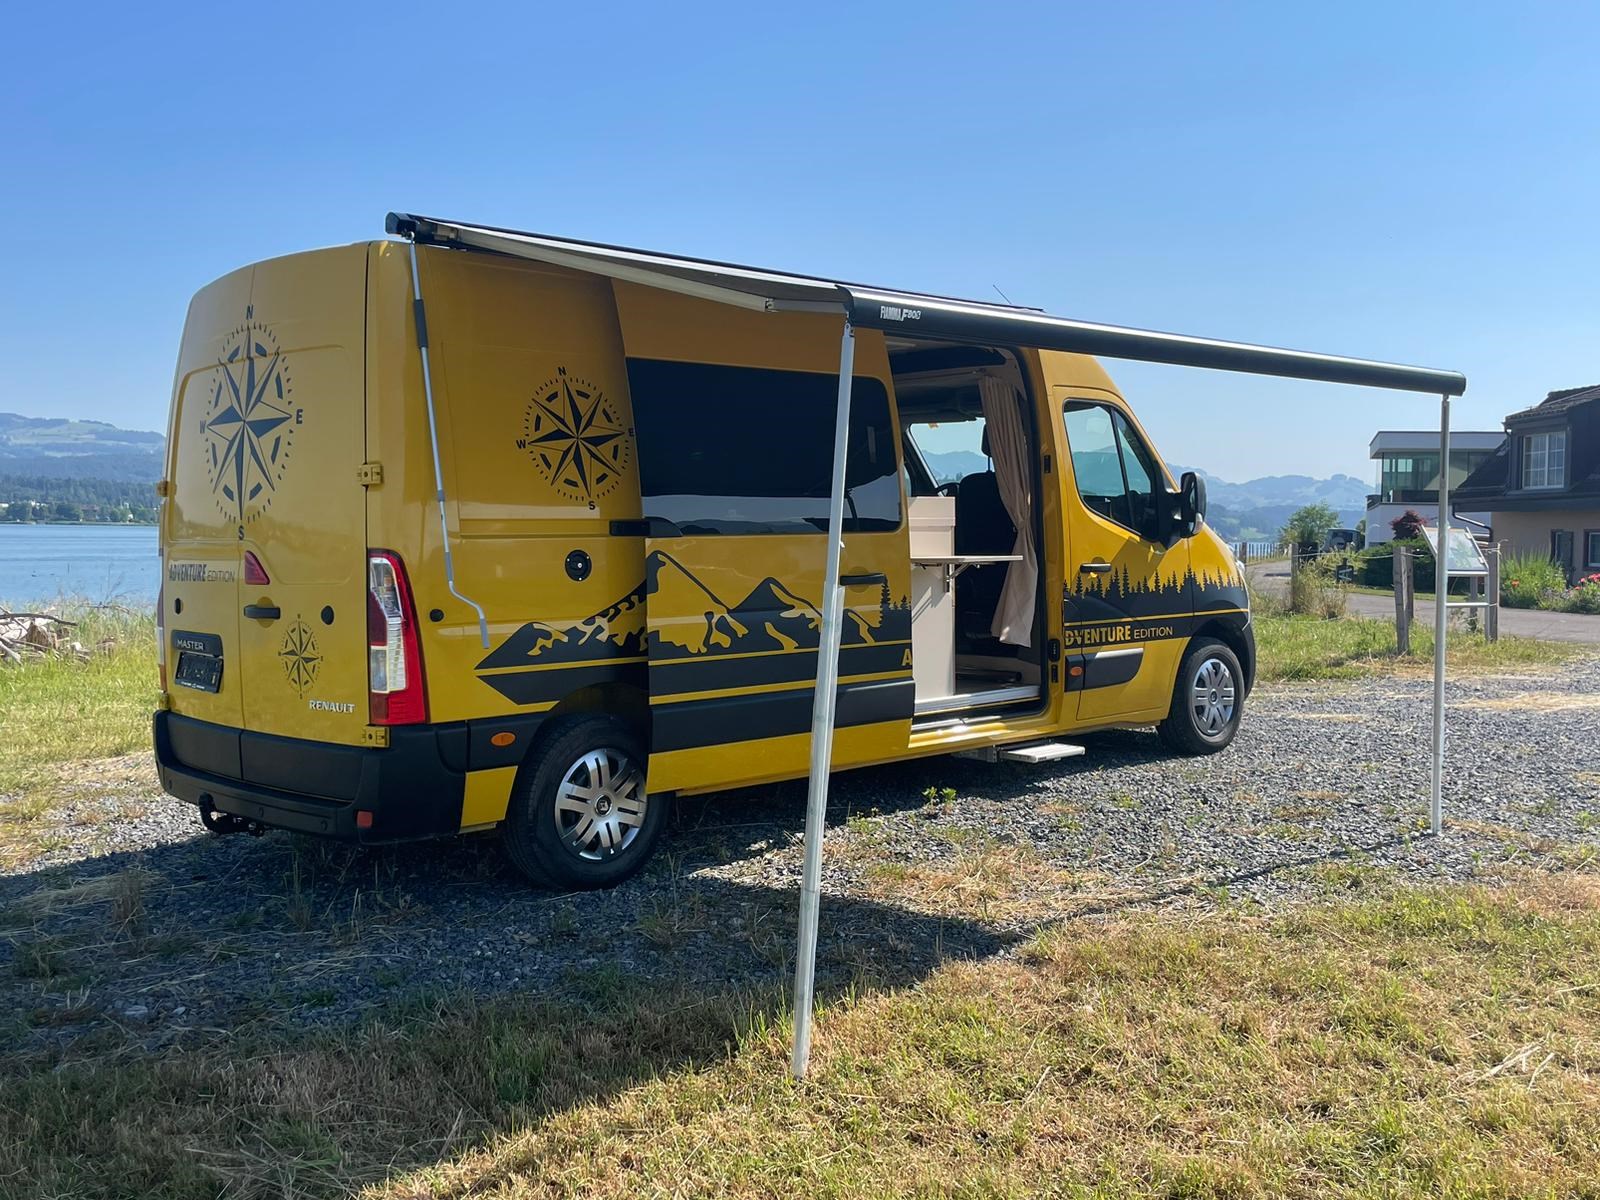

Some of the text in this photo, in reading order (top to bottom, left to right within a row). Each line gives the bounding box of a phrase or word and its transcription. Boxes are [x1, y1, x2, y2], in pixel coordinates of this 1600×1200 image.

[246, 304, 254, 320] N
[557, 366, 567, 376] N
[296, 409, 304, 424] E
[516, 439, 527, 449] W
[588, 500, 597, 511] S
[238, 525, 245, 541] S
[169, 563, 236, 582] ADVENTURE EDITION
[1133, 627, 1173, 639] EDITION
[176, 639, 204, 651] MASTER
[902, 648, 913, 666] A
[309, 700, 355, 714] RENAULT
